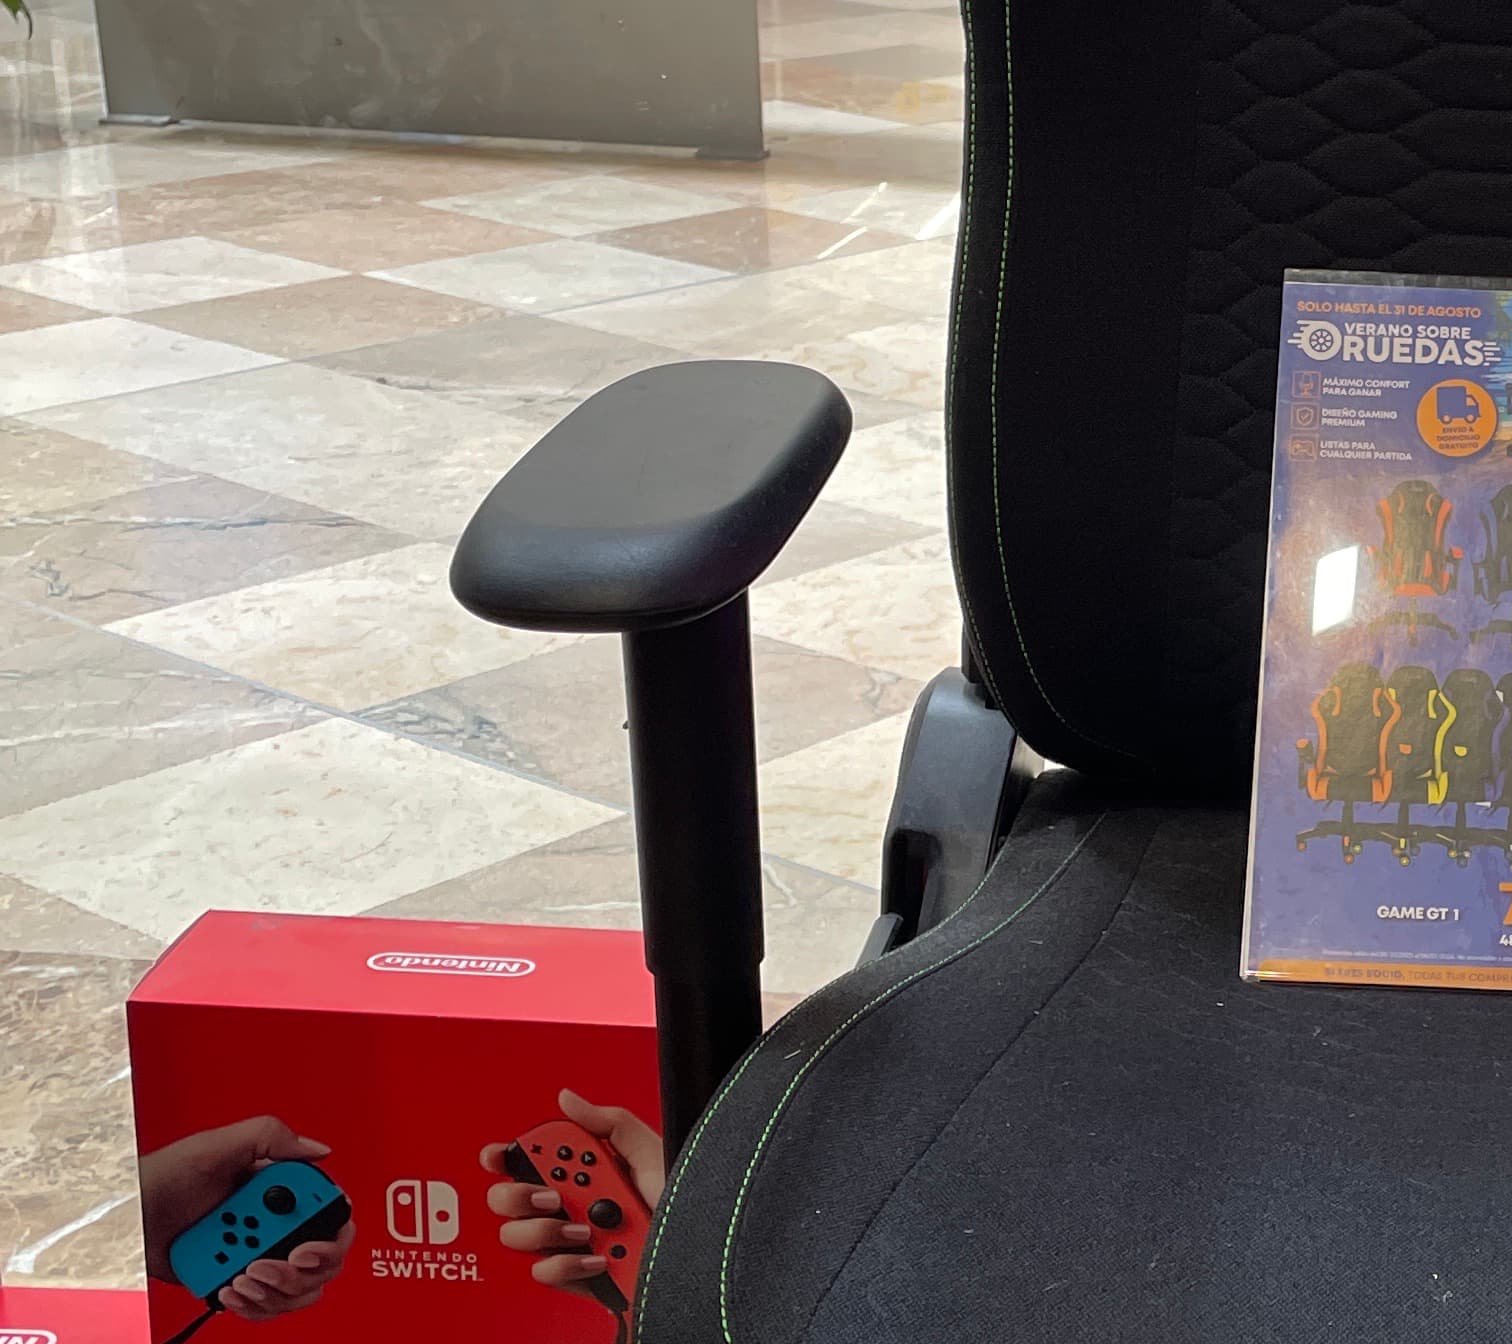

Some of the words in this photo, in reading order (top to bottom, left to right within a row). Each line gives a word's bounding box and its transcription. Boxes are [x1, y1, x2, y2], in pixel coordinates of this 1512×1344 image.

[1296, 301, 1331, 312] SOLO
[1335, 303, 1376, 314] HASTA
[1379, 304, 1391, 315] EL
[1394, 305, 1405, 315] 31
[1409, 305, 1424, 316] DE
[1427, 306, 1482, 318] AGOSTO
[1345, 322, 1412, 337] VERANO
[1417, 325, 1471, 340] SOBRE
[1342, 336, 1484, 367] RUEDAS
[1365, 379, 1410, 389] CONFORT
[1323, 387, 1347, 396] PARA
[1349, 388, 1381, 397] GANAR
[1321, 407, 1356, 418] DISEÑO
[1358, 409, 1397, 419] GAMING
[1321, 417, 1366, 427] PREMIUM
[1320, 440, 1349, 450] LISTAS
[1351, 441, 1375, 451] PARA
[1439, 442, 1479, 450] GRATUITO
[1320, 450, 1372, 460] CUALQUIER
[1374, 451, 1412, 461] PARTIDA
[1377, 905, 1424, 920] GAME
[1427, 907, 1448, 920] GT
[1453, 908, 1460, 921] 1
[382, 955, 520, 974] Nintendo
[371, 1248, 478, 1263] NINTENDO
[371, 1262, 484, 1281] SWITCH
